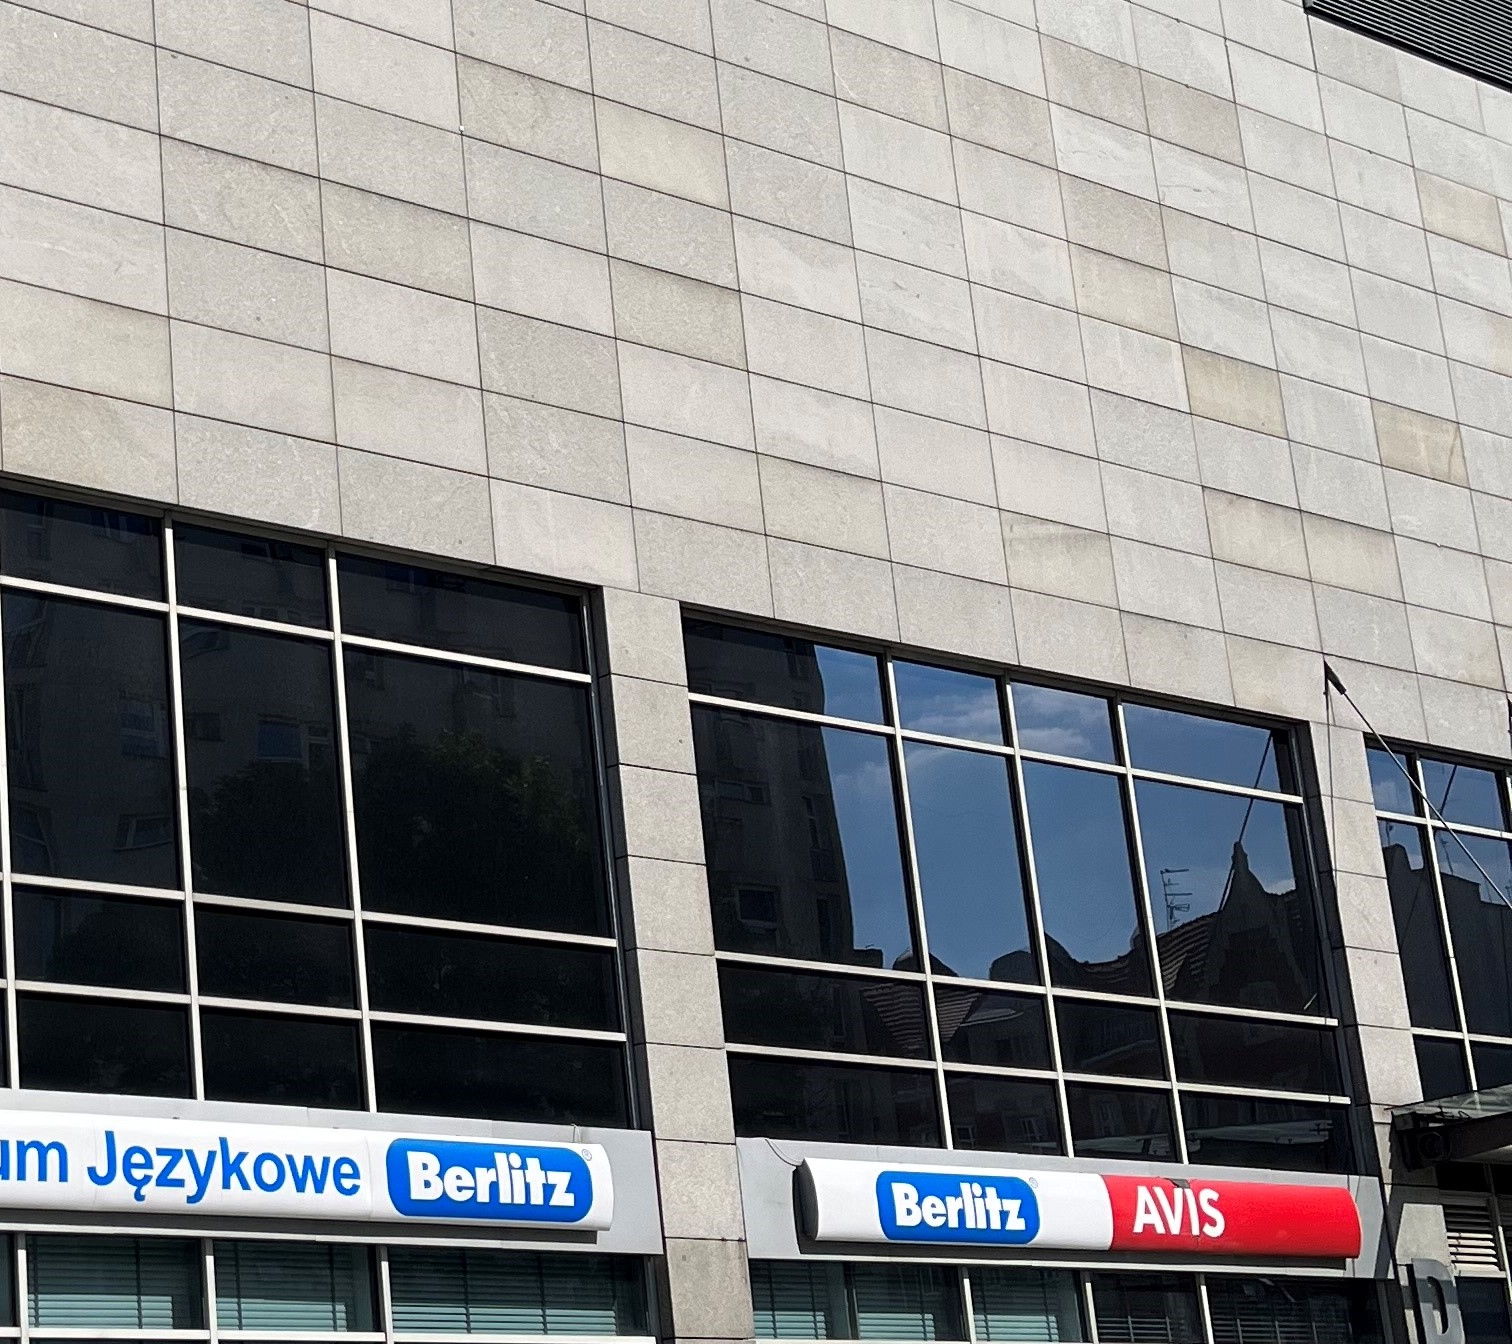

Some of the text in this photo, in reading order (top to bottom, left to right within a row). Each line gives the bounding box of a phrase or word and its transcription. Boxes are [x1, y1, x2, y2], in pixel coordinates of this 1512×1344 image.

[86, 1128, 362, 1207] Językowe
[406, 1150, 576, 1208] Berlitz
[891, 1181, 1027, 1232] Berlitz
[1132, 1185, 1226, 1239] AVIS
